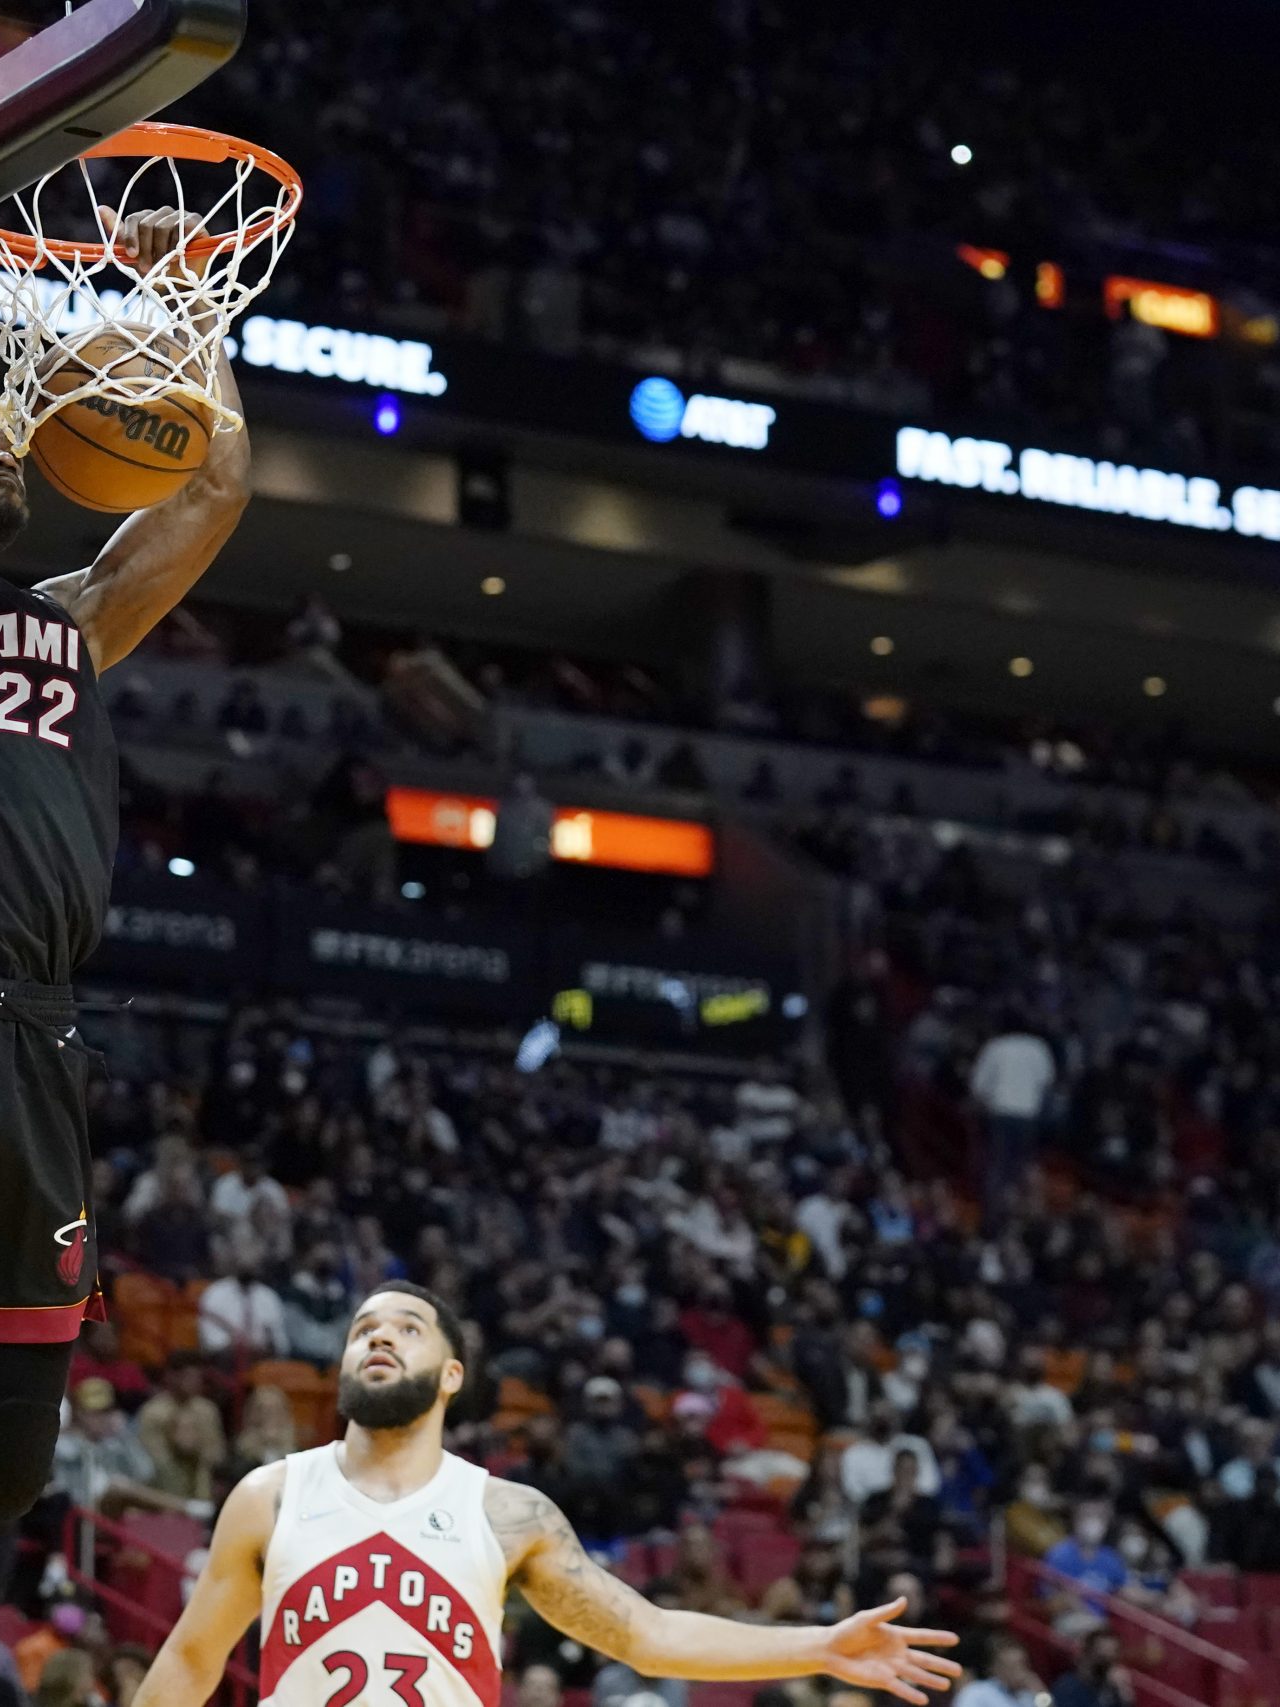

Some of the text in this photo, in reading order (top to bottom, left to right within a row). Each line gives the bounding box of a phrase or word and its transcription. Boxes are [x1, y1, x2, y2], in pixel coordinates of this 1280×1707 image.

[242, 315, 448, 397] SECURE.
[282, 1553, 475, 1661] RAPTORS
[322, 1650, 429, 1707] 23
